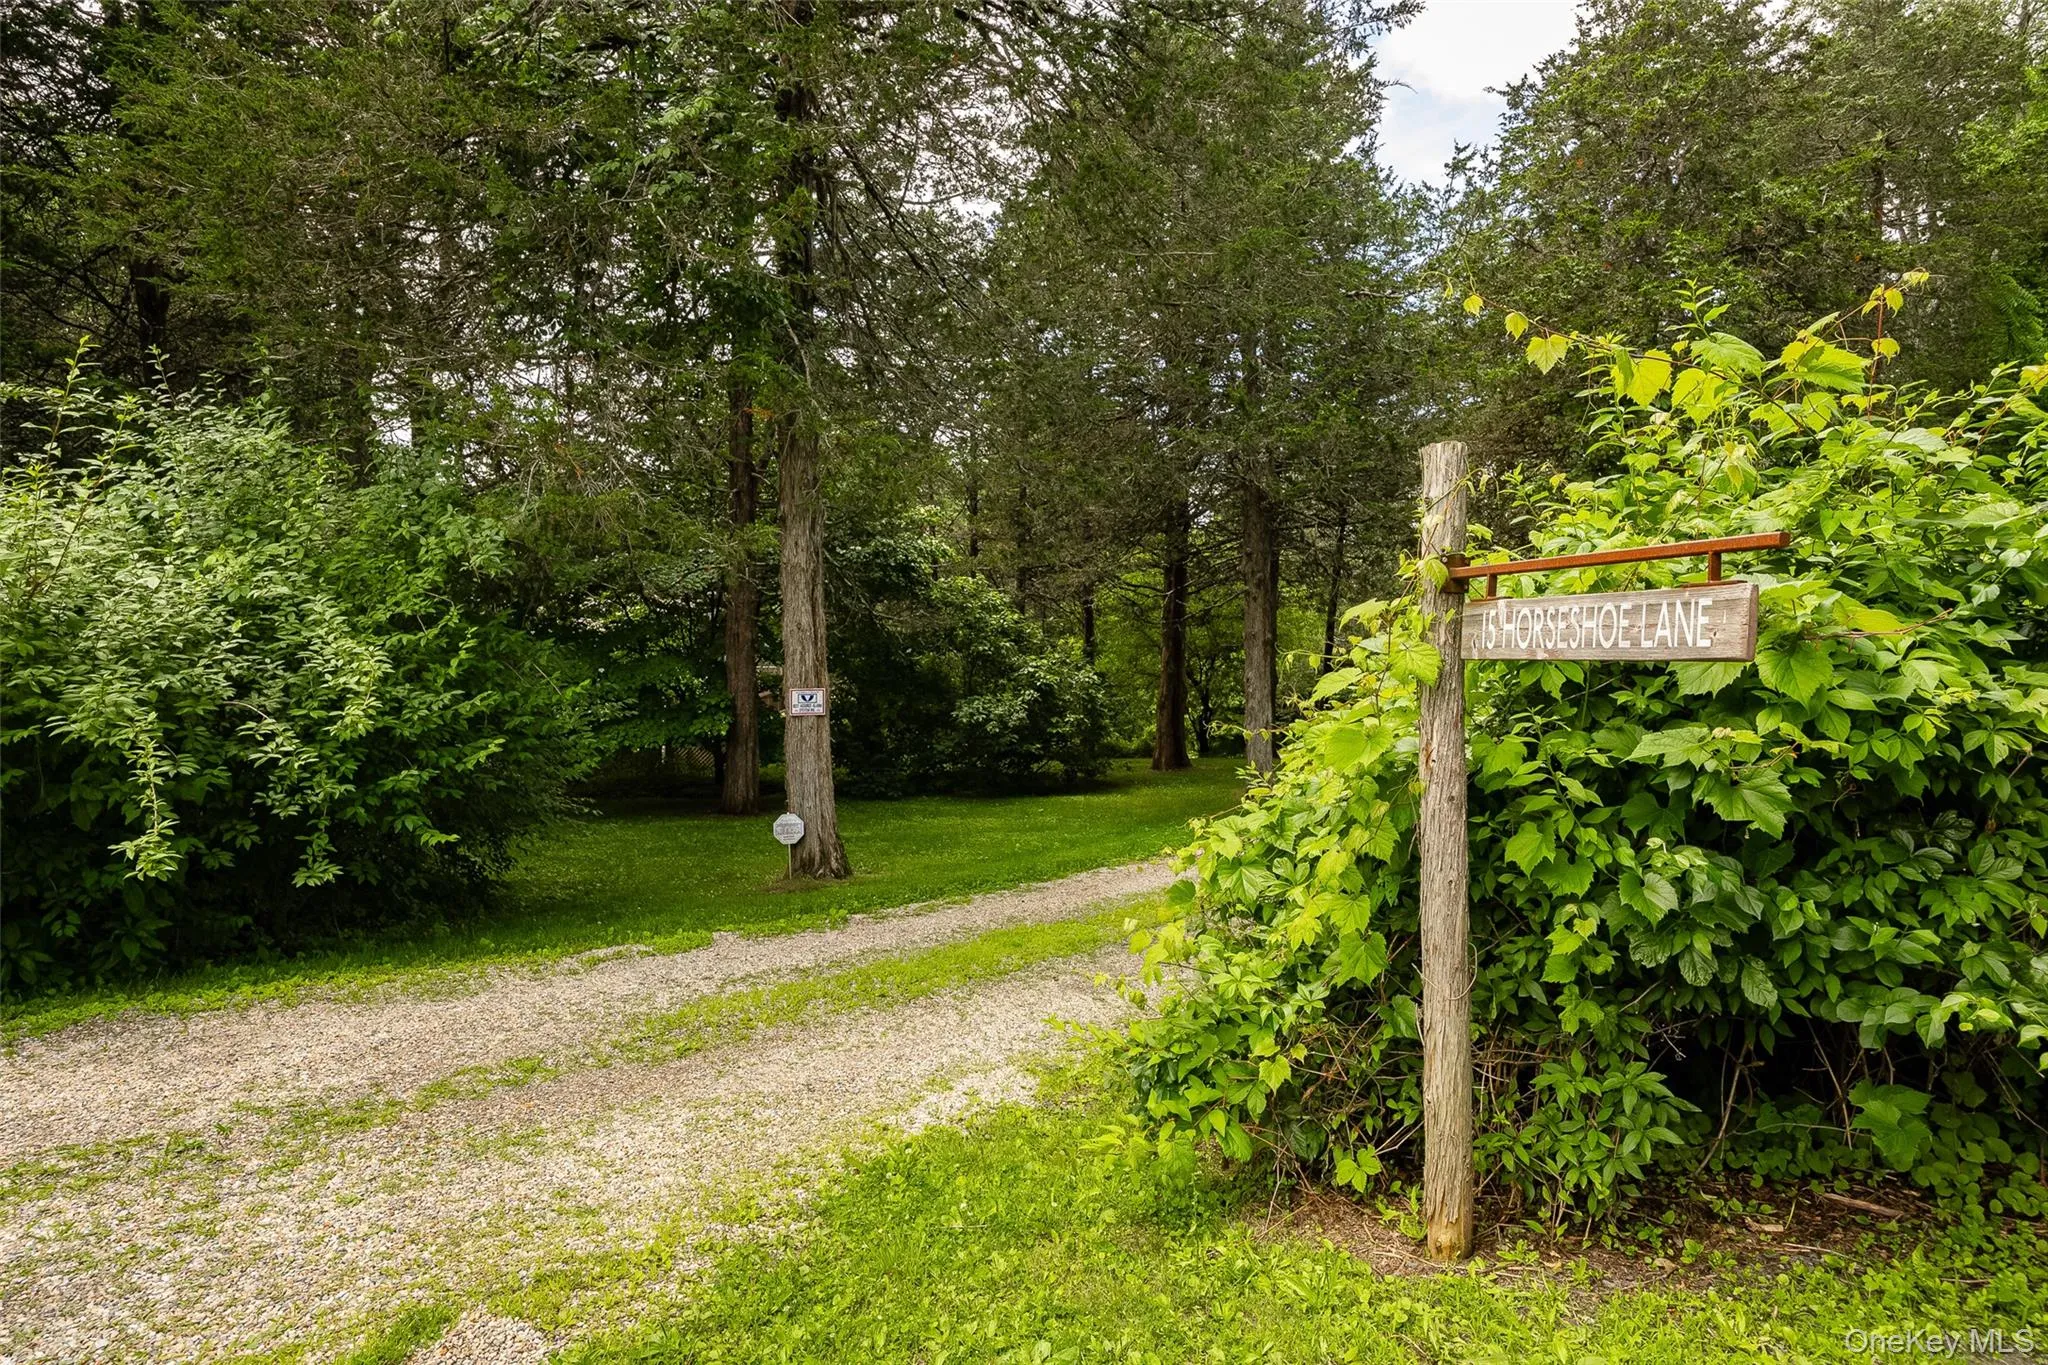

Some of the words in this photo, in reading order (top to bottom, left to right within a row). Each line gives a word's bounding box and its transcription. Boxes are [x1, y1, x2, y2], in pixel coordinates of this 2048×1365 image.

[1481, 609, 1496, 650] 15
[1501, 602, 1632, 650] HORSESHOE
[1640, 598, 1713, 648] LANE
